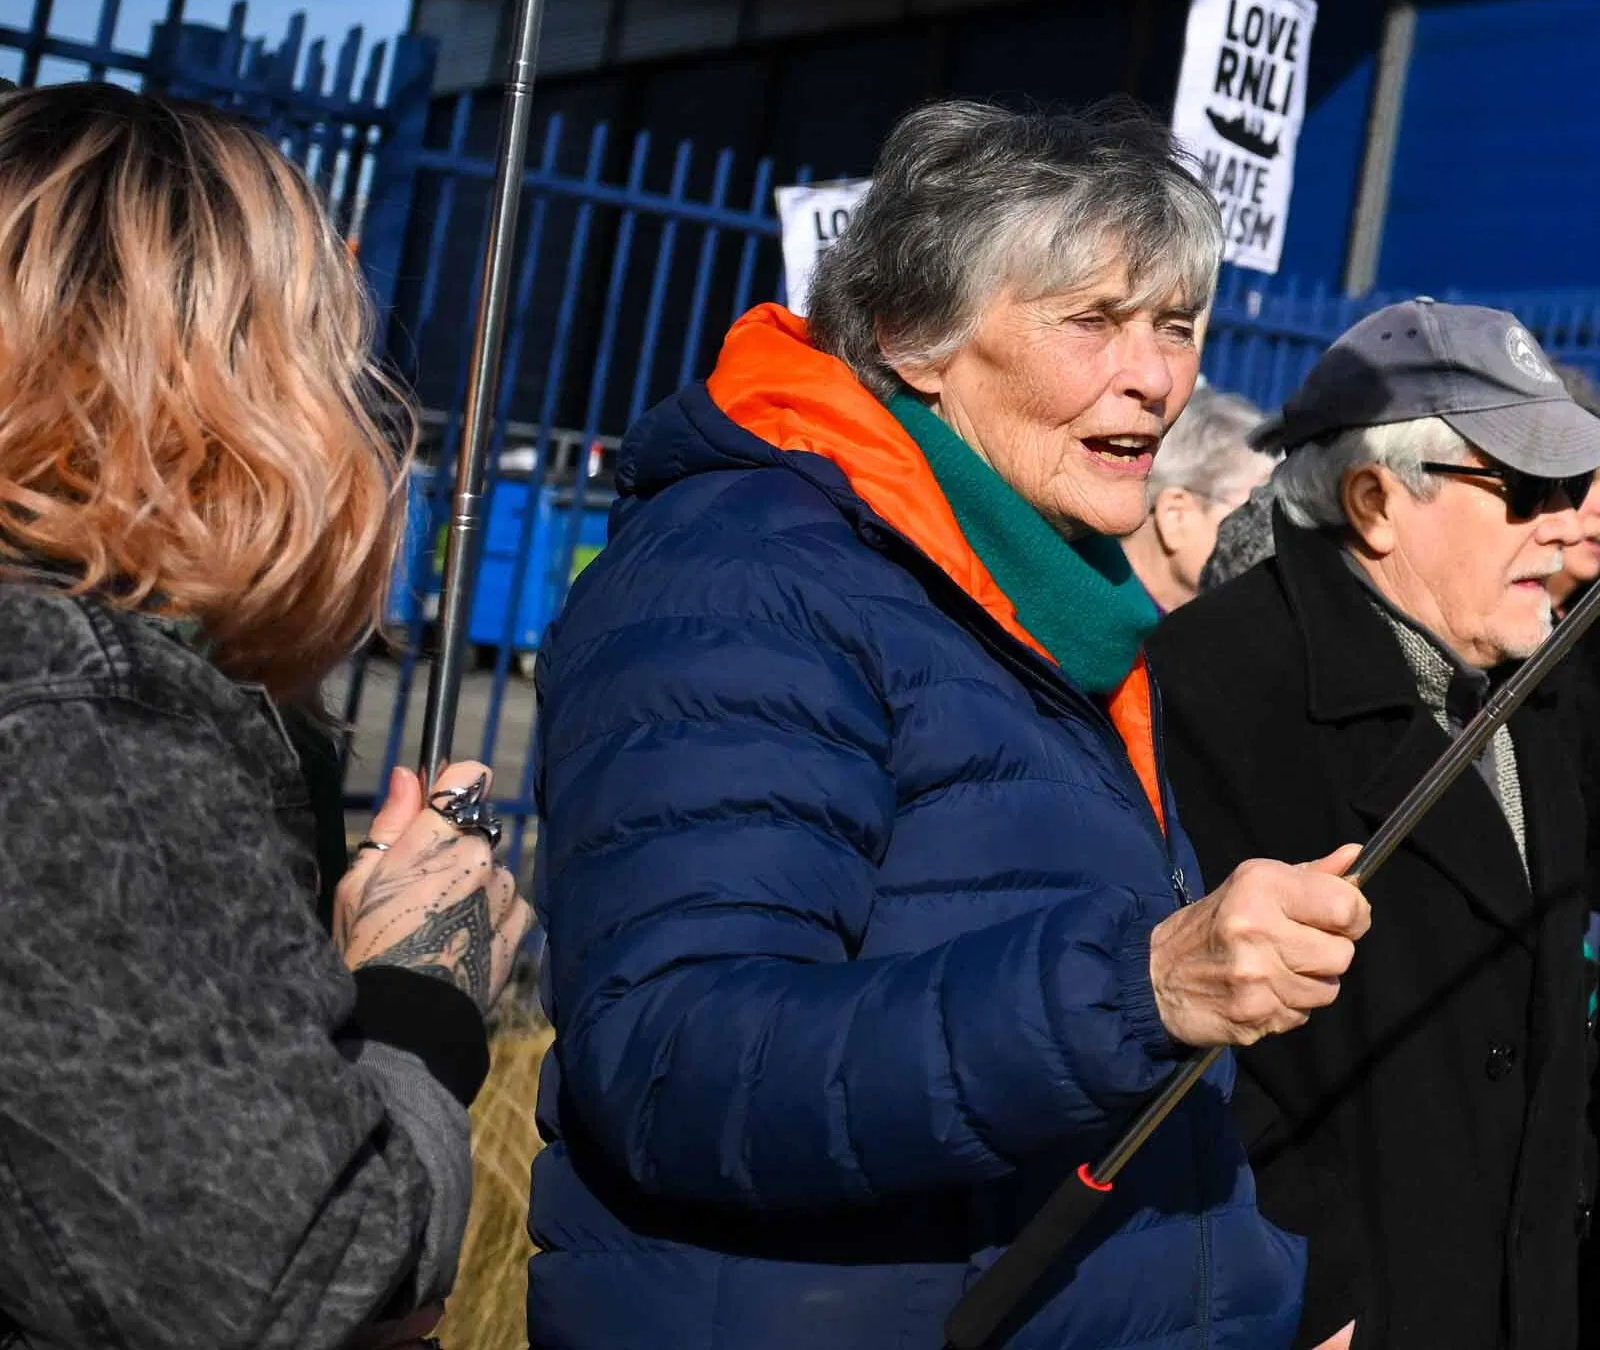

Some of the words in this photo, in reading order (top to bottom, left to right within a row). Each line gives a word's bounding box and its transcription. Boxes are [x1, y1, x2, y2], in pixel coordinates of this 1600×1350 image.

[1214, 46, 1295, 116] RNLI
[1204, 150, 1271, 204] HATE
[814, 208, 850, 241] LO
